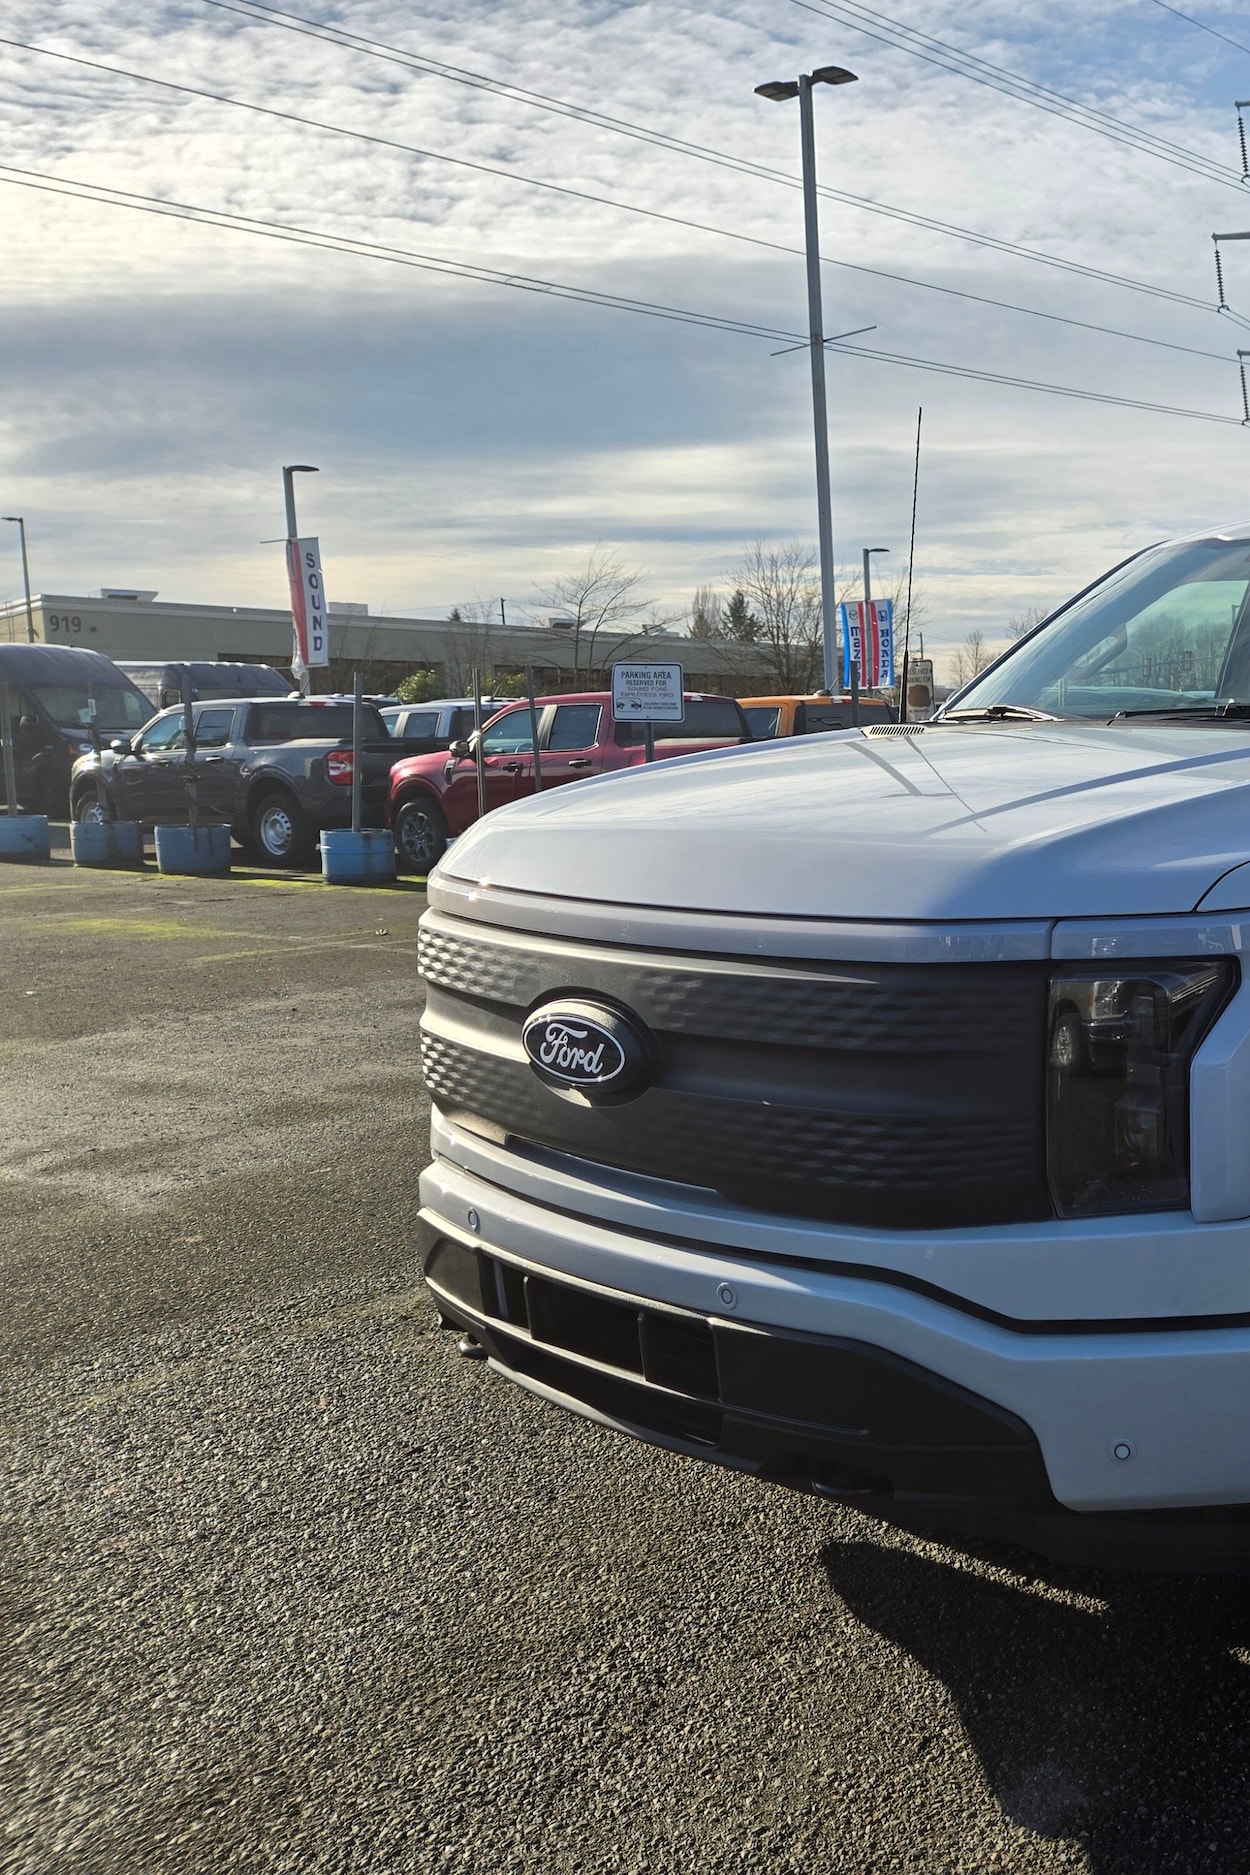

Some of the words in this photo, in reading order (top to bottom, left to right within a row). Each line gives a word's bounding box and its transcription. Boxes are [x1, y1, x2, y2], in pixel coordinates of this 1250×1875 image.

[305, 552, 323, 652] SOUND
[49, 614, 82, 633] 919
[879, 628, 890, 678] HONDA
[620, 671, 651, 680] PARKING
[652, 671, 672, 680] AREA
[625, 679, 655, 687] RESERVED
[655, 679, 667, 687] FOR
[539, 1022, 605, 1075] Ford
